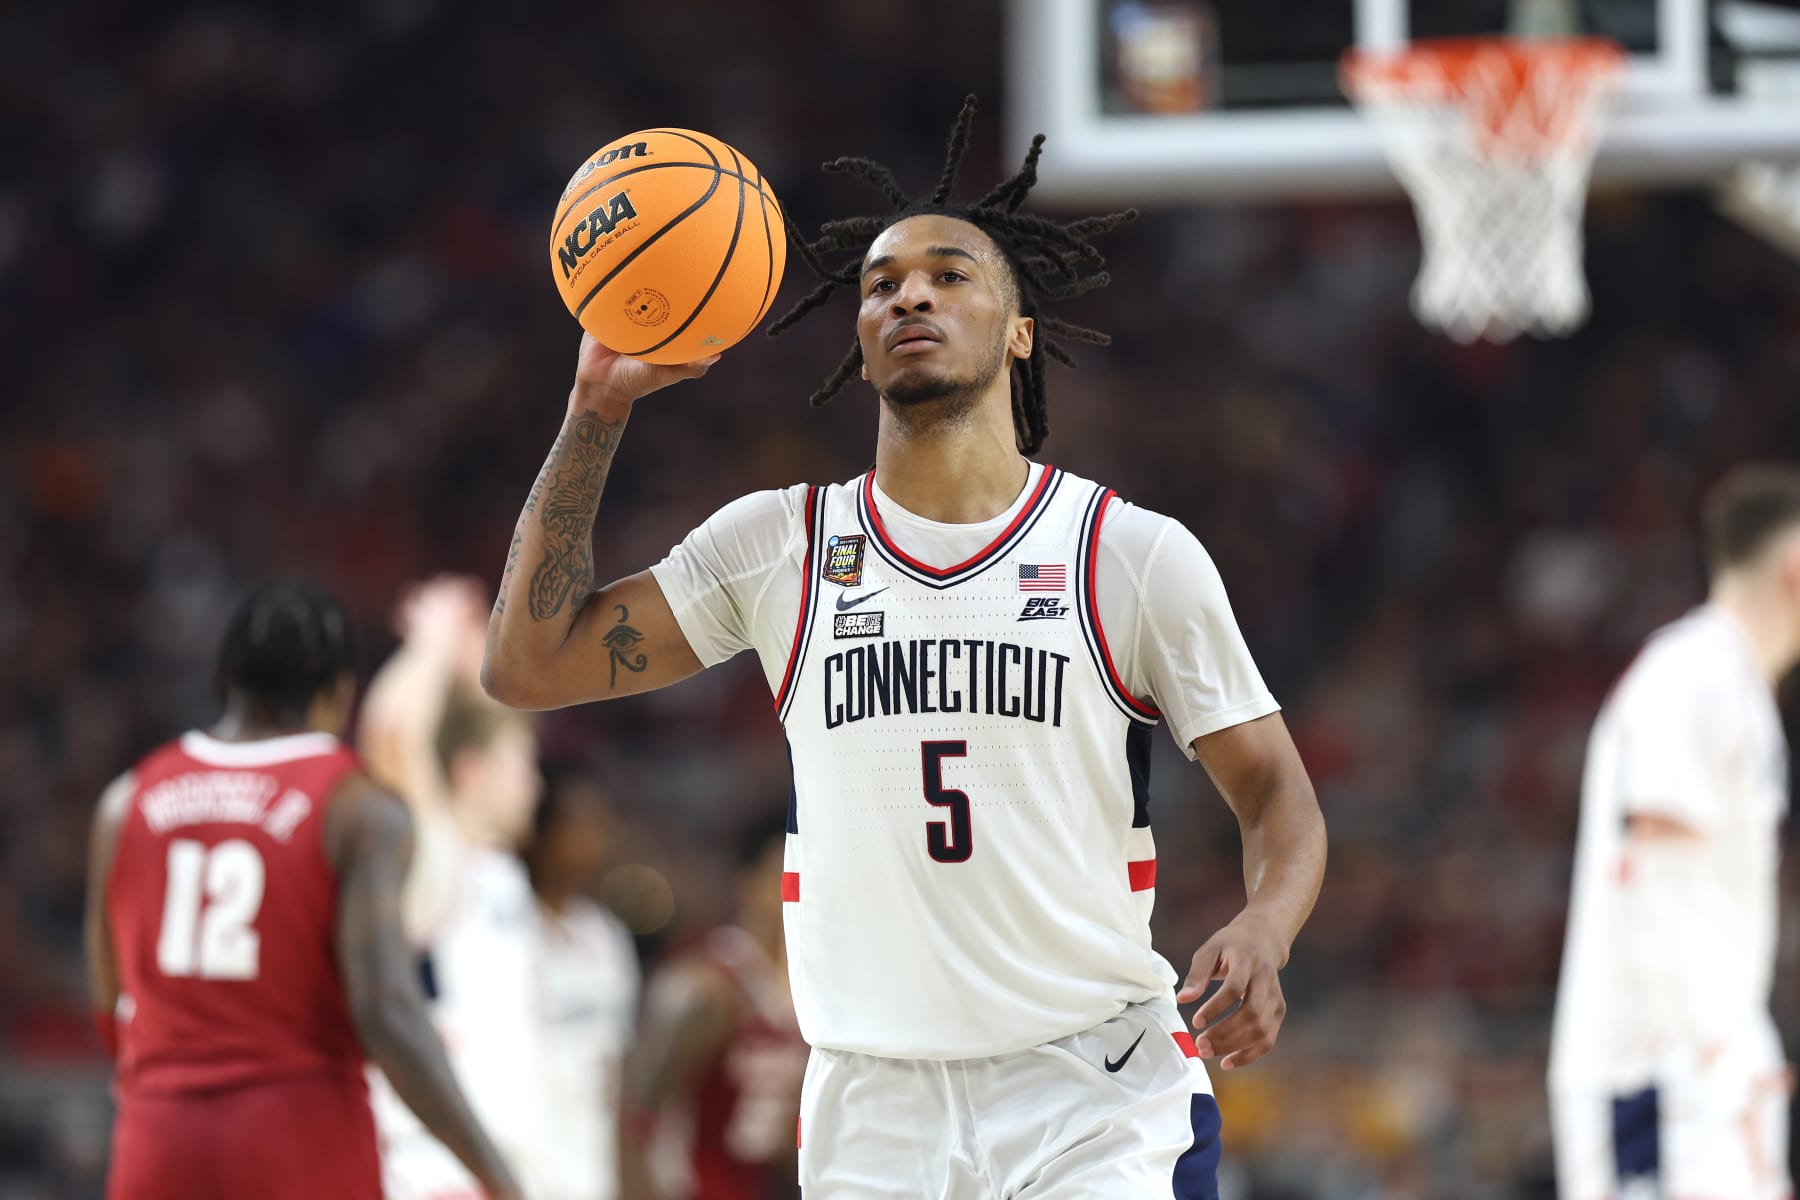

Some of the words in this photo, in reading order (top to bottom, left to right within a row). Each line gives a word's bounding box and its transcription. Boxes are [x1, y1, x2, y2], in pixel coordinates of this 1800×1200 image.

[558, 191, 638, 280] NCAA
[590, 237, 614, 259] GAME
[614, 222, 640, 239] BALL
[829, 555, 856, 568] FOUR
[831, 543, 857, 557] FINAL
[1020, 607, 1070, 617] EAST
[1026, 597, 1060, 608] BIG
[835, 625, 881, 636] CHANGE
[824, 639, 1070, 730] CONNECTICUT
[920, 740, 973, 863] 5
[157, 838, 265, 981] 12
